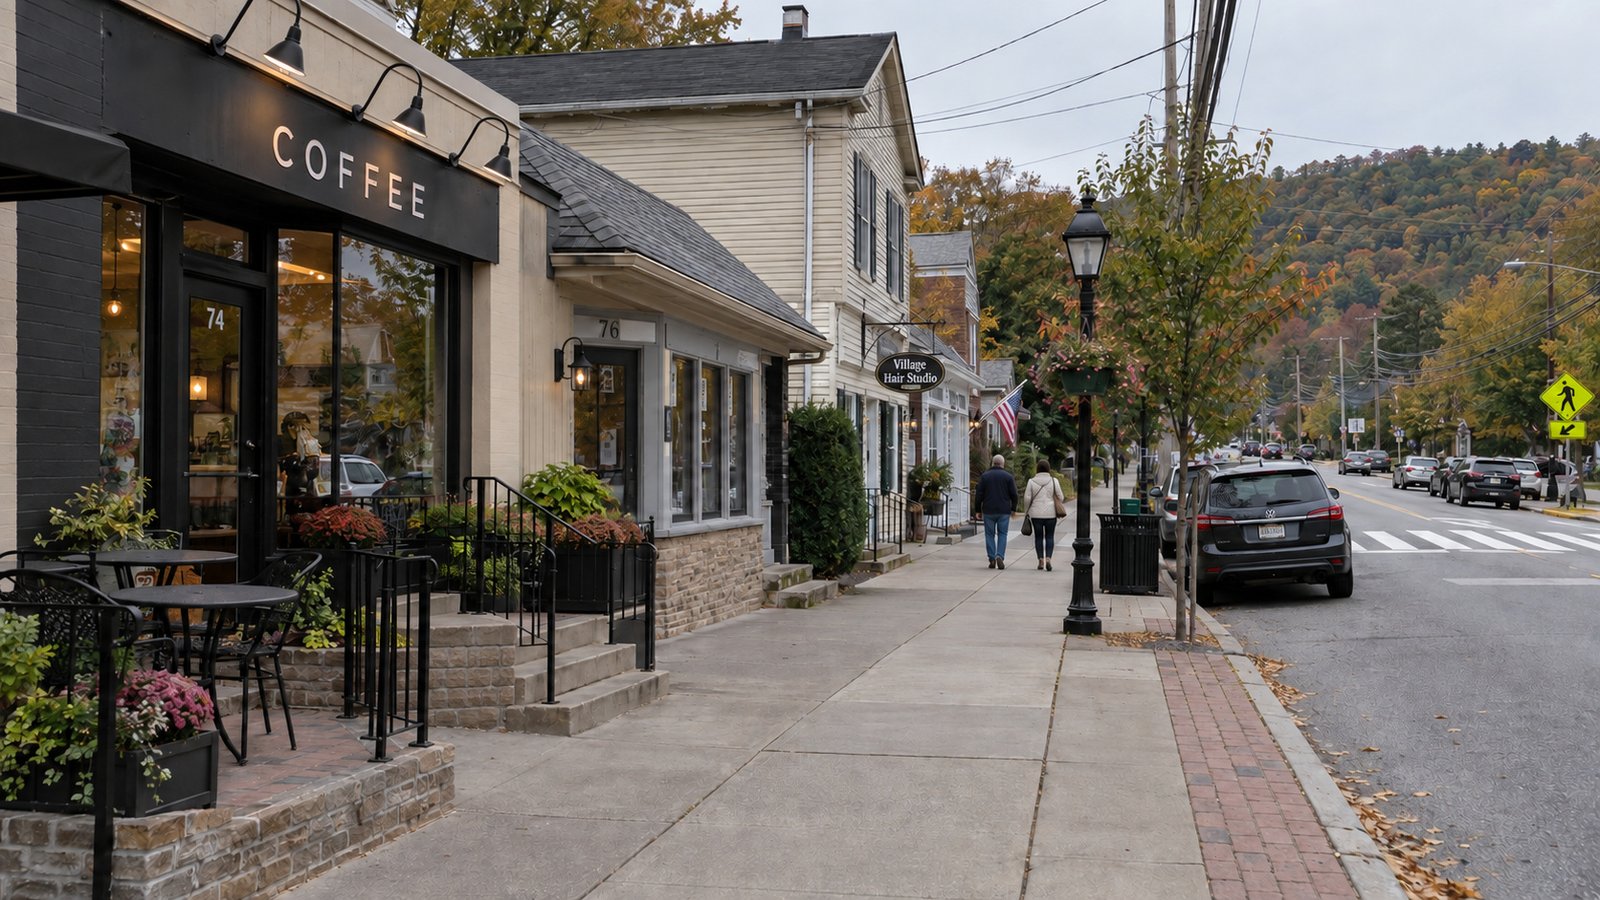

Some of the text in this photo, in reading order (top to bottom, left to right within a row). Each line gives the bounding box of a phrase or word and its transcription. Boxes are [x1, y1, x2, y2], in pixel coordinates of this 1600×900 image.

[273, 125, 425, 219] COFFEE
[207, 307, 225, 331] 74
[599, 319, 619, 339] 76
[893, 358, 927, 373] Village
[883, 372, 938, 383] Hair Studio
